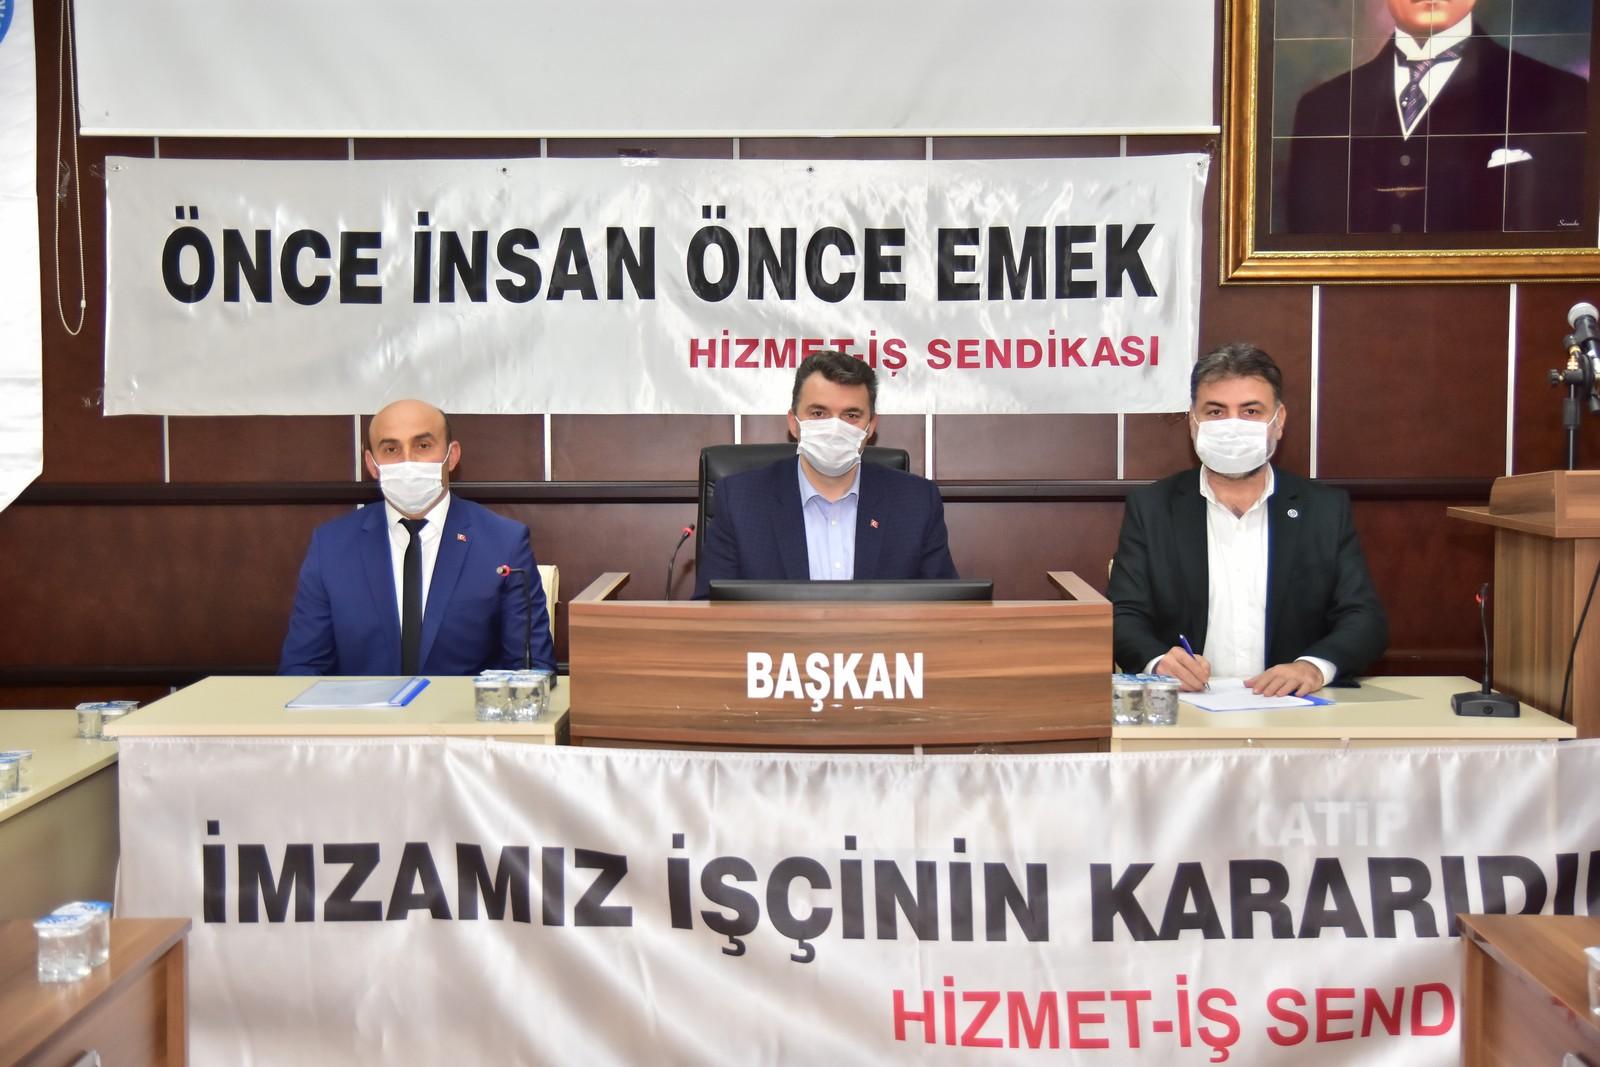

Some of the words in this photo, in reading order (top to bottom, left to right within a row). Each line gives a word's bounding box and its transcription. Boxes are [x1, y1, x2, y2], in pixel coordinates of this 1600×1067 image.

[161, 205, 383, 305] ÖNCE
[412, 211, 656, 304] İNSAN
[686, 205, 907, 304] ÖNCE
[937, 223, 1158, 302] EMEK
[927, 329, 1159, 369] SENDİKASI
[747, 652, 924, 712] BAŞKAN
[202, 820, 633, 926] İMZAMIZ
[667, 833, 1049, 963] İŞÇİNİN
[1090, 849, 1600, 941] KARARIDI
[892, 974, 1242, 1063] HİZMET-İŞ
[1266, 982, 1456, 1047] SEND
